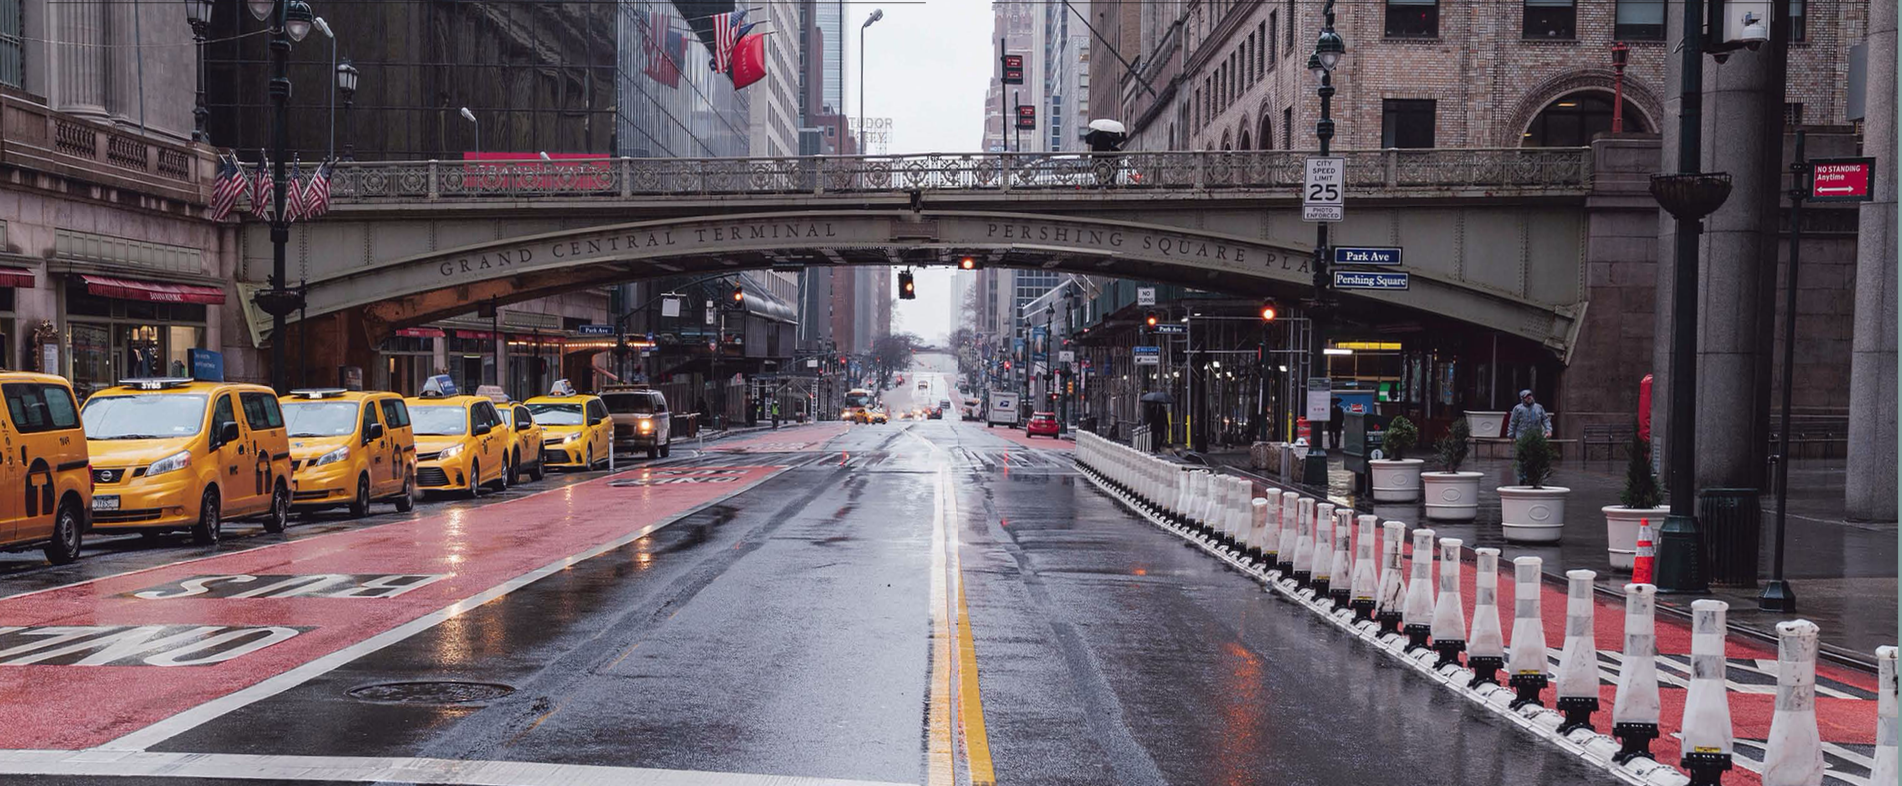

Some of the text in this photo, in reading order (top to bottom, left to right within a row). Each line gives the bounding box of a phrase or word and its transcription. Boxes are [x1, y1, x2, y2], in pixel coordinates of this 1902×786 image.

[848, 117, 893, 129] TUDOR
[1828, 165, 1861, 173] STANDING
[1817, 173, 1845, 182] Anytime
[1309, 184, 1339, 201] 25
[440, 223, 836, 277] GRAND CENTRAL TERMINAL
[987, 223, 1310, 274] PERSHING SQUARE PLA
[1346, 251, 1390, 261] Park Ave
[1336, 274, 1406, 287] Pershing Square
[134, 574, 452, 599] BUS
[0, 626, 300, 667] ONL
